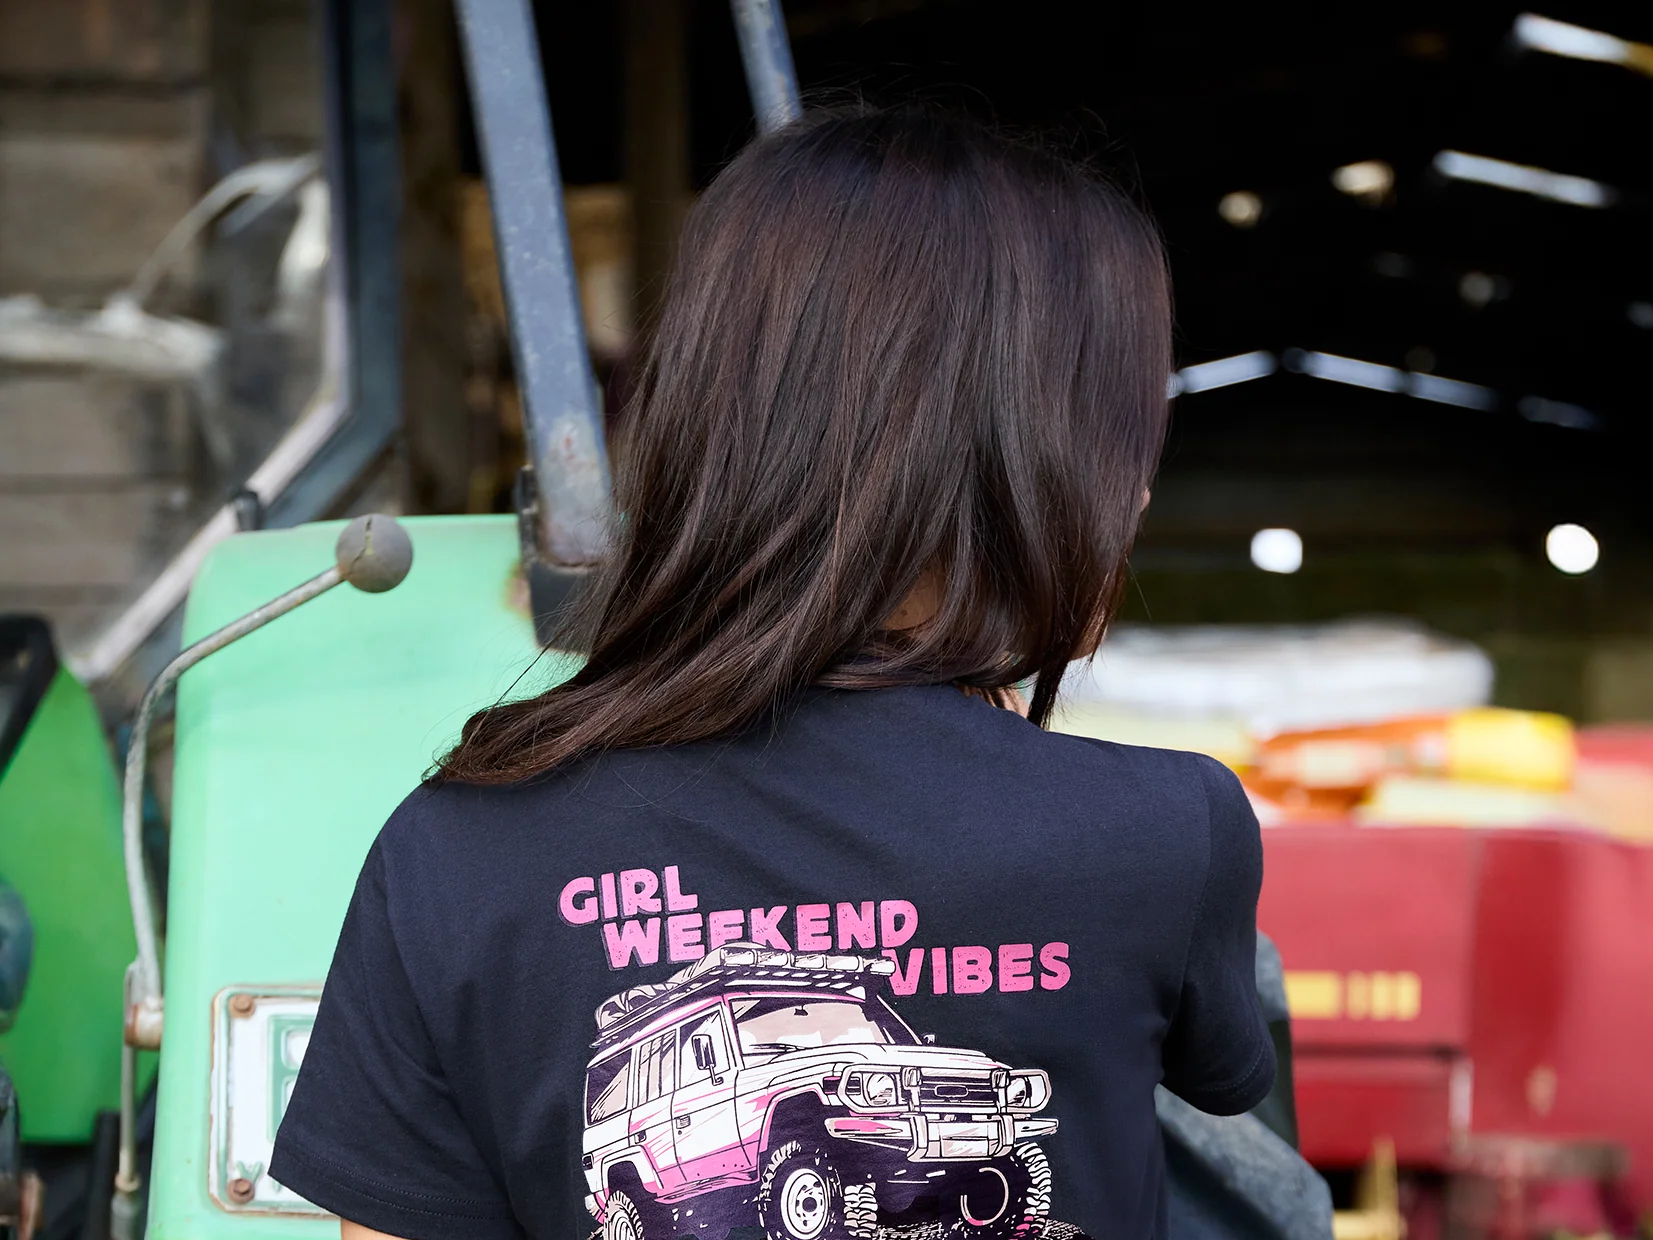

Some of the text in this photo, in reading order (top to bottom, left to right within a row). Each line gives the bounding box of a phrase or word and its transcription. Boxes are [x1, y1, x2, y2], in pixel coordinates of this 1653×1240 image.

[558, 865, 698, 926] GIRL
[601, 900, 918, 970] WEEKEND
[881, 941, 1072, 996] VIBES
